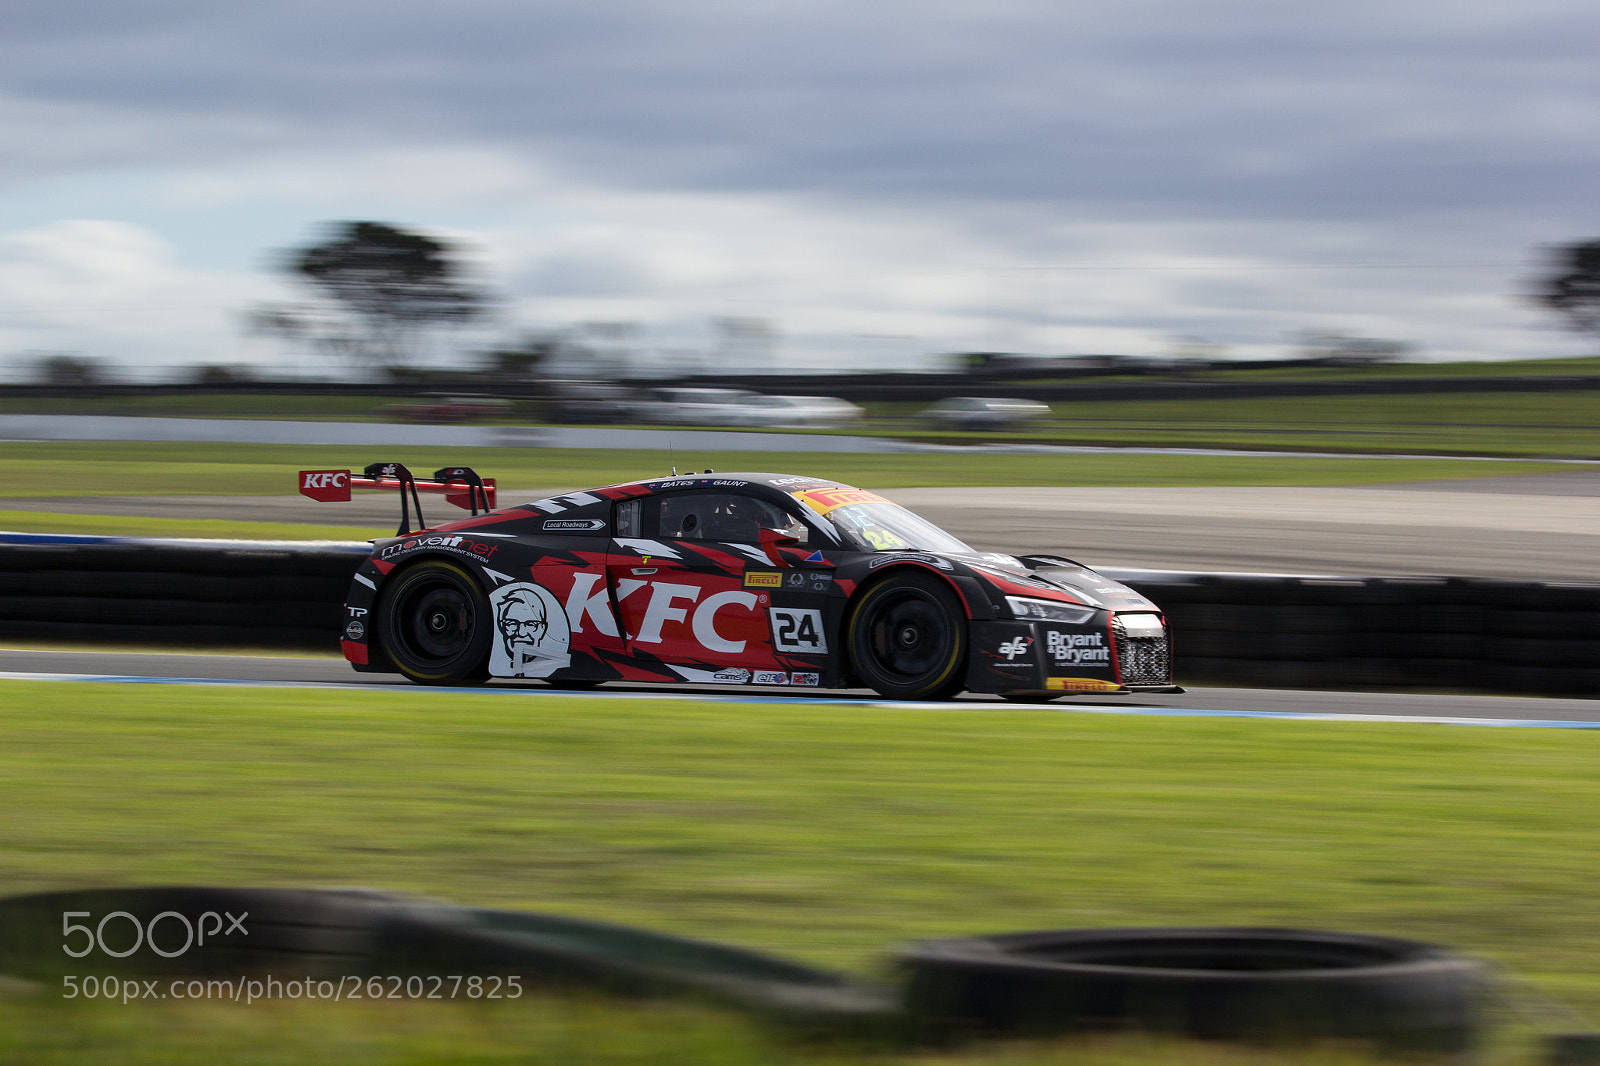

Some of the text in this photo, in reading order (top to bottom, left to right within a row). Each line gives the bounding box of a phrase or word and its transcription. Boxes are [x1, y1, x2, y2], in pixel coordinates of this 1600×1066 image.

[304, 473, 347, 488] KFC
[661, 480, 695, 488] BATES
[713, 480, 748, 488] GAUNT
[863, 530, 903, 550] 24
[381, 551, 400, 560] ONLINE
[427, 545, 465, 555] MANAGEMENT
[466, 551, 489, 563] SYSTEM
[748, 574, 779, 585] PIRELLI
[347, 606, 368, 618] TP
[565, 572, 759, 653] KFC
[775, 612, 819, 647] 24
[1047, 630, 1102, 649] Bryant
[998, 636, 1028, 660] afs
[1062, 680, 1107, 691] PIRELLI
